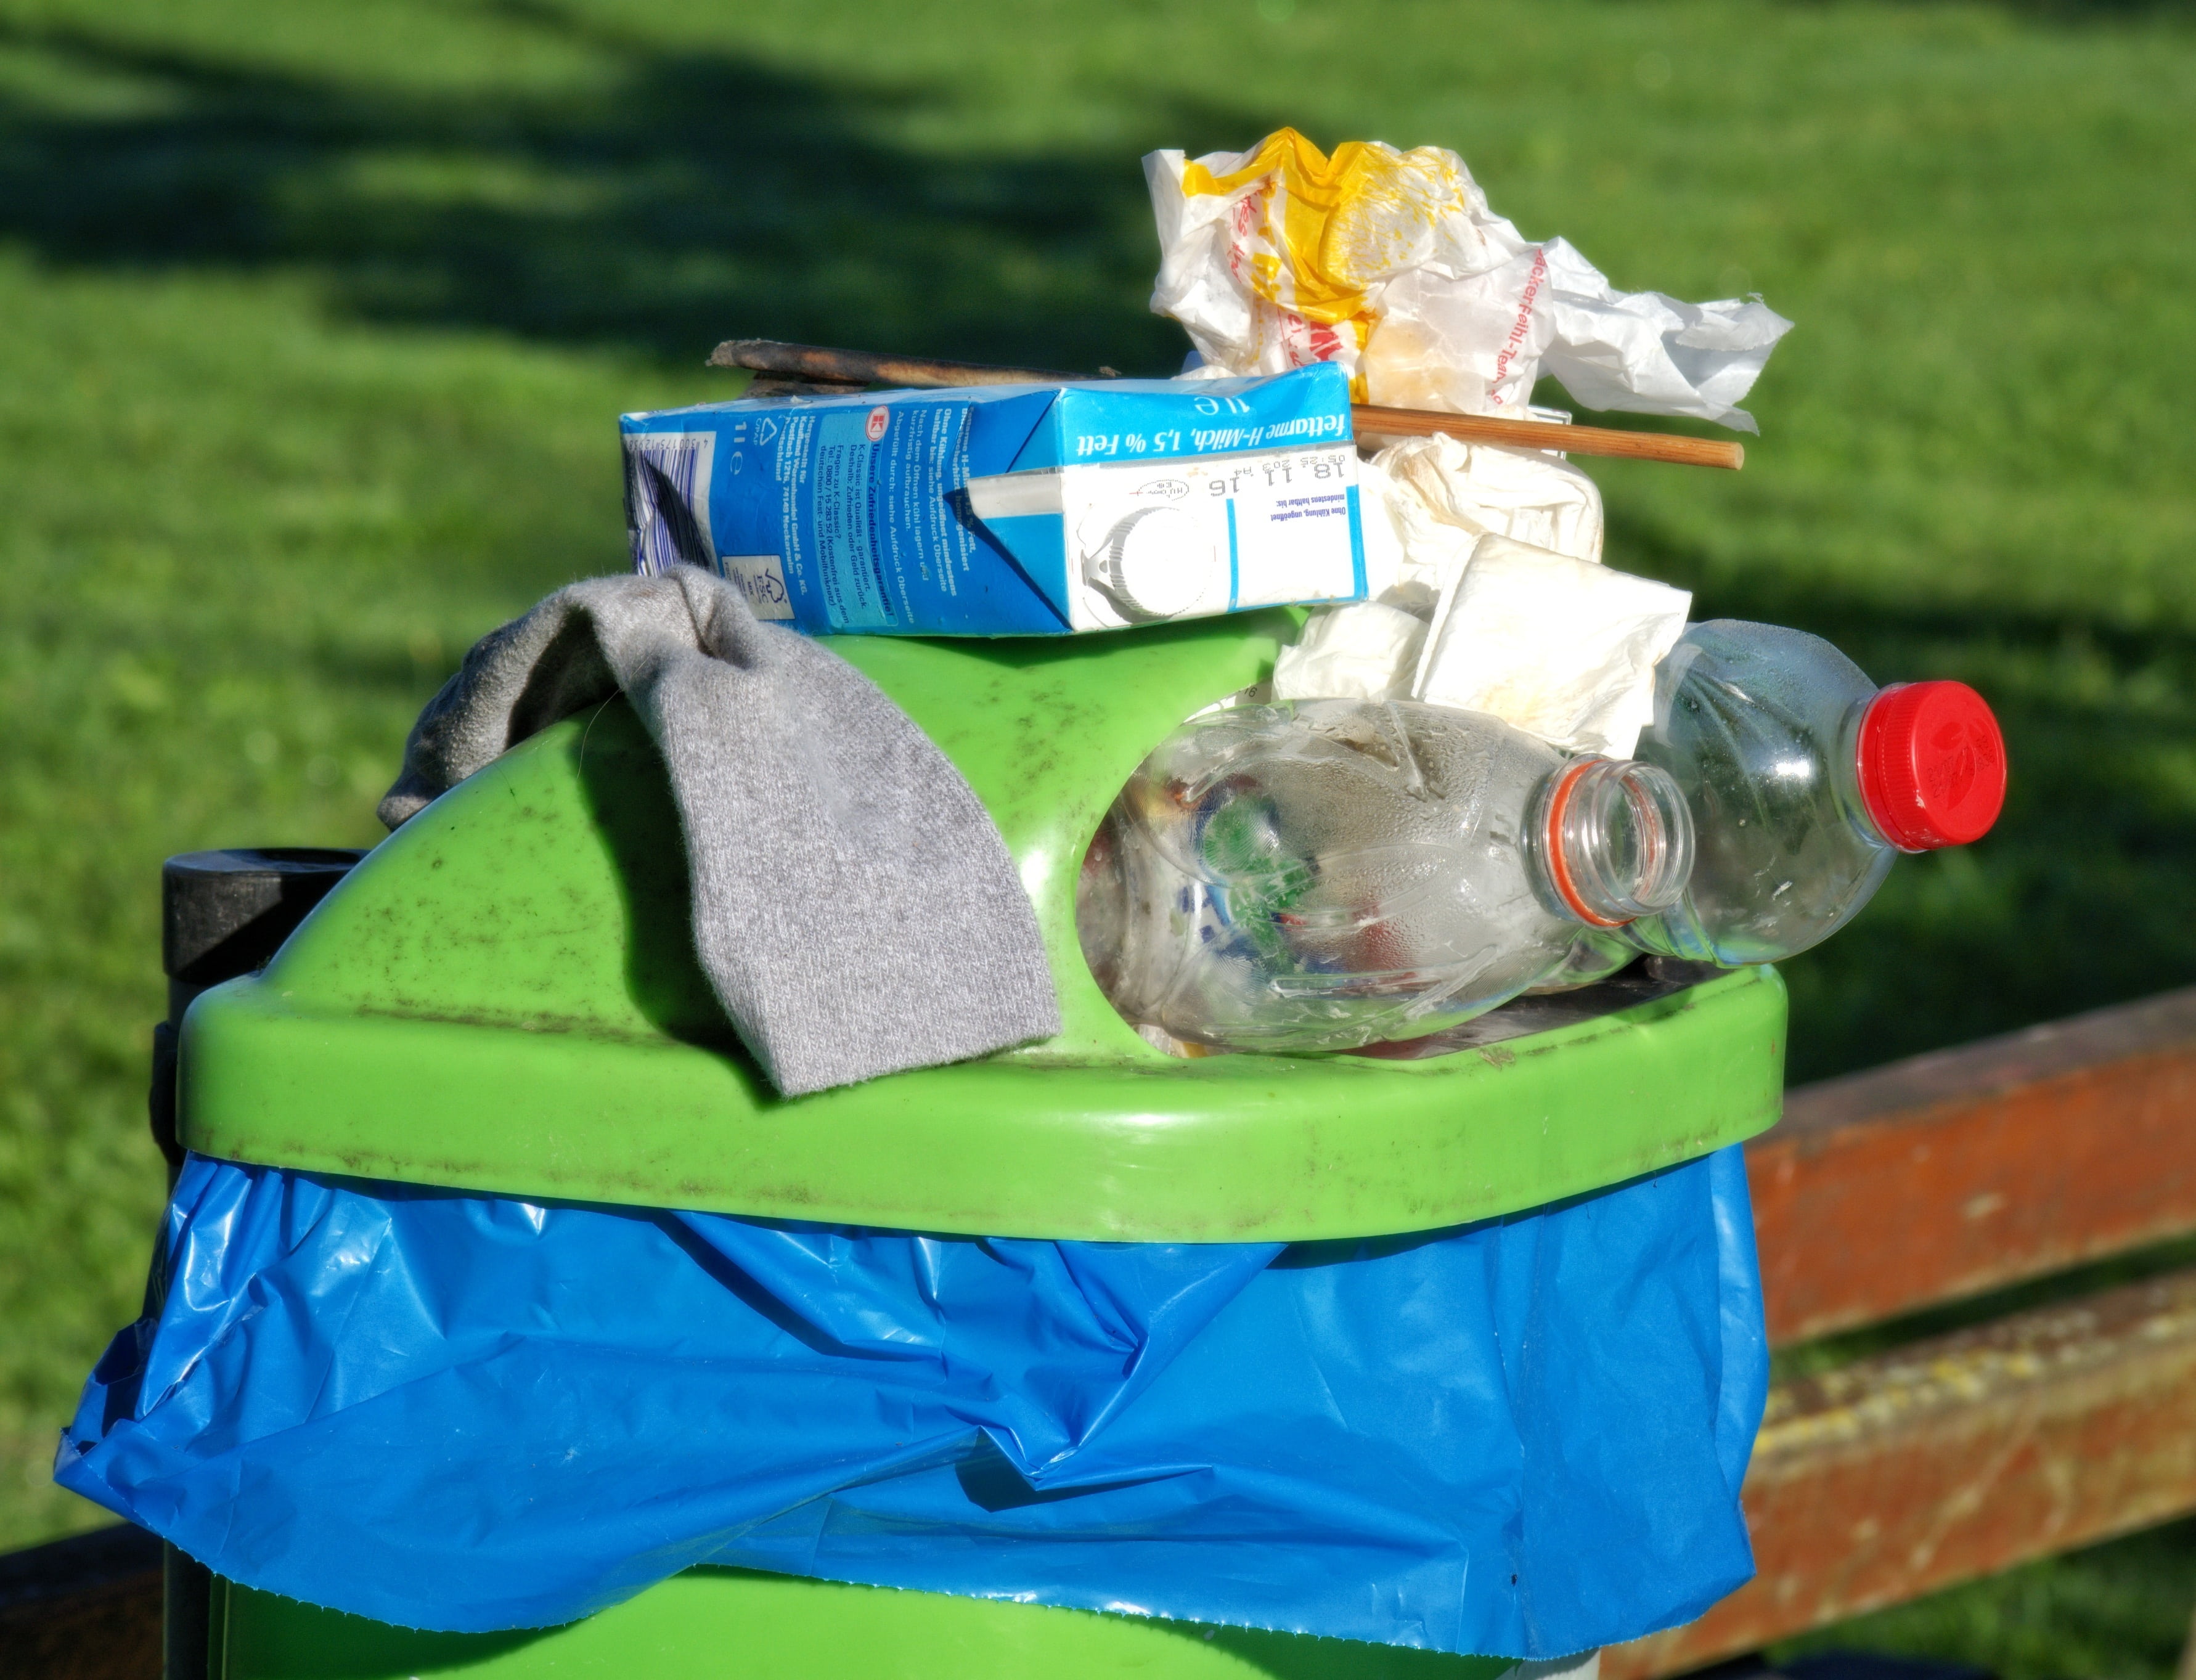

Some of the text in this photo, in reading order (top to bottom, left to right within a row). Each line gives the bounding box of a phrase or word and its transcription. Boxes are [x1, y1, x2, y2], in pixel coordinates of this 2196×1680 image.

[786, 417, 799, 458] Postfach
[794, 416, 807, 456] Kaufland
[891, 411, 904, 457] Abgefüllt
[916, 410, 927, 436] Nach
[931, 409, 943, 444] haltbar
[1076, 414, 1345, 456] fettarme H-Milch, 1,5 % Fett
[626, 439, 655, 451] 12938
[801, 416, 815, 468] Hergestellt
[827, 446, 835, 463] Tel.:
[834, 445, 844, 476] Fragen
[929, 446, 937, 463] bis:
[817, 446, 826, 493] deutschen
[847, 444, 857, 484] Deshalb:
[855, 444, 865, 486] K-Classic
[889, 460, 897, 492] durch:
[904, 410, 918, 531] kurzfristig aufbrauchen.
[913, 465, 921, 499] Öffnen
[791, 458, 800, 520] Warenhandel
[825, 494, 831, 504] 15
[834, 479, 839, 488] zu
[1276, 494, 1345, 508] mindestens haltbar bis:
[913, 502, 921, 523] kühl
[929, 496, 939, 542] Aufdruck
[936, 408, 957, 597] Ohne Kühlung, ungeöffnet mindestens
[1271, 507, 1346, 521] Ohne Kühlung, ungeöffnet
[783, 515, 794, 574] Neckarsulm
[791, 523, 800, 551] GmbH
[826, 523, 832, 534] 52
[868, 444, 894, 616] Unsere Zufriedenheitsgarantie!
[914, 526, 925, 558] lagern
[827, 536, 839, 585] (Kostenfrei
[851, 555, 859, 575] Geld
[889, 526, 902, 573] Aufdruck
[934, 544, 947, 592] Oberseite
[819, 540, 836, 606] Mobilfunknetz)
[856, 546, 871, 591] garantiert.
[757, 575, 769, 603] FSC
[835, 587, 844, 603] aus
[897, 576, 914, 623] Oberseite
[839, 605, 849, 623] dem
